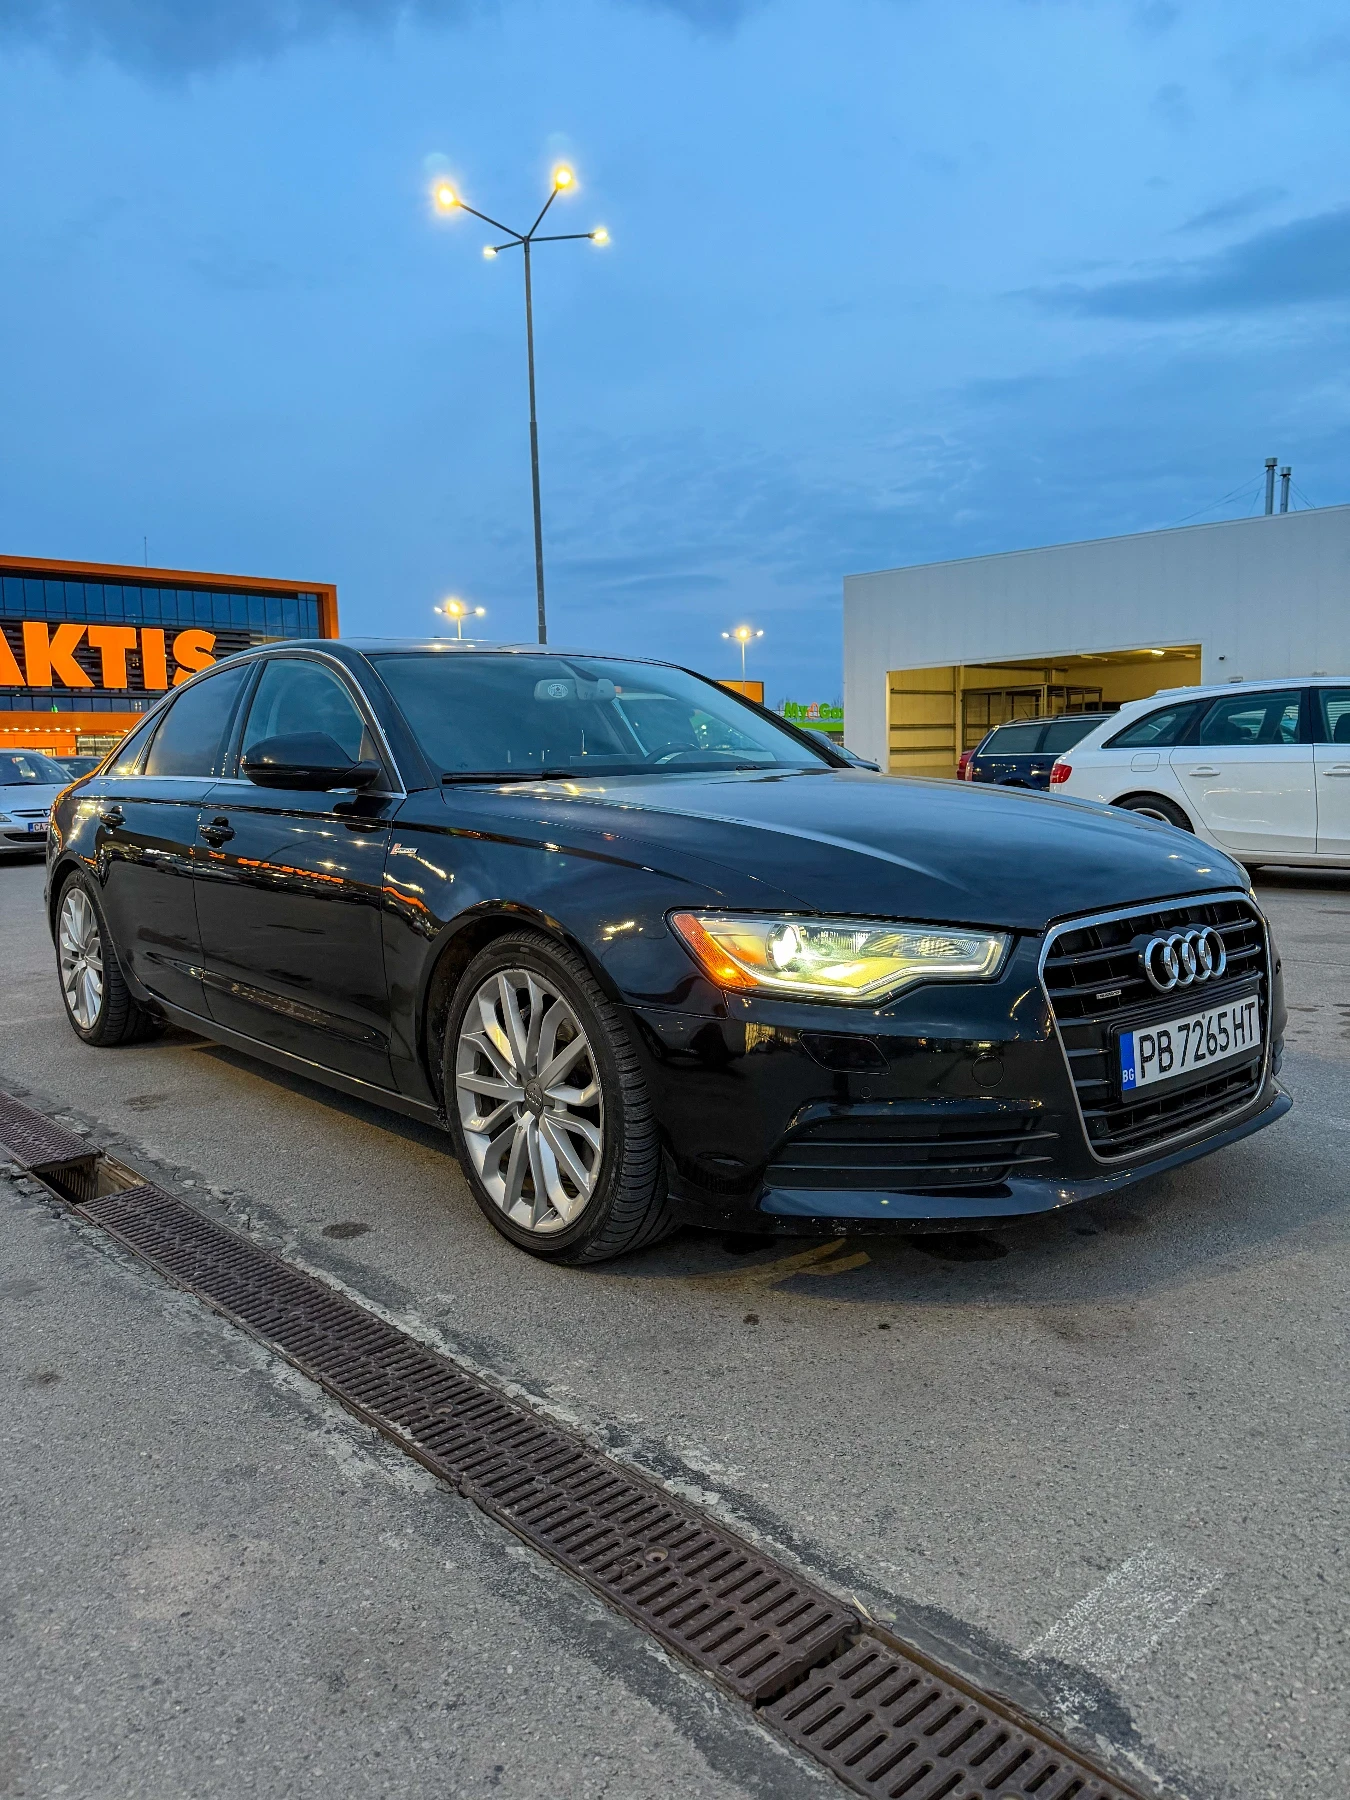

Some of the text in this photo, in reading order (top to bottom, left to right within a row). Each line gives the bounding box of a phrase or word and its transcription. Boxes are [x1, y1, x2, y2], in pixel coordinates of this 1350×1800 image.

[785, 702, 844, 720] My Ga
[1139, 1001, 1256, 1079] PB 7265 HT
[1122, 1067, 1135, 1083] BG
